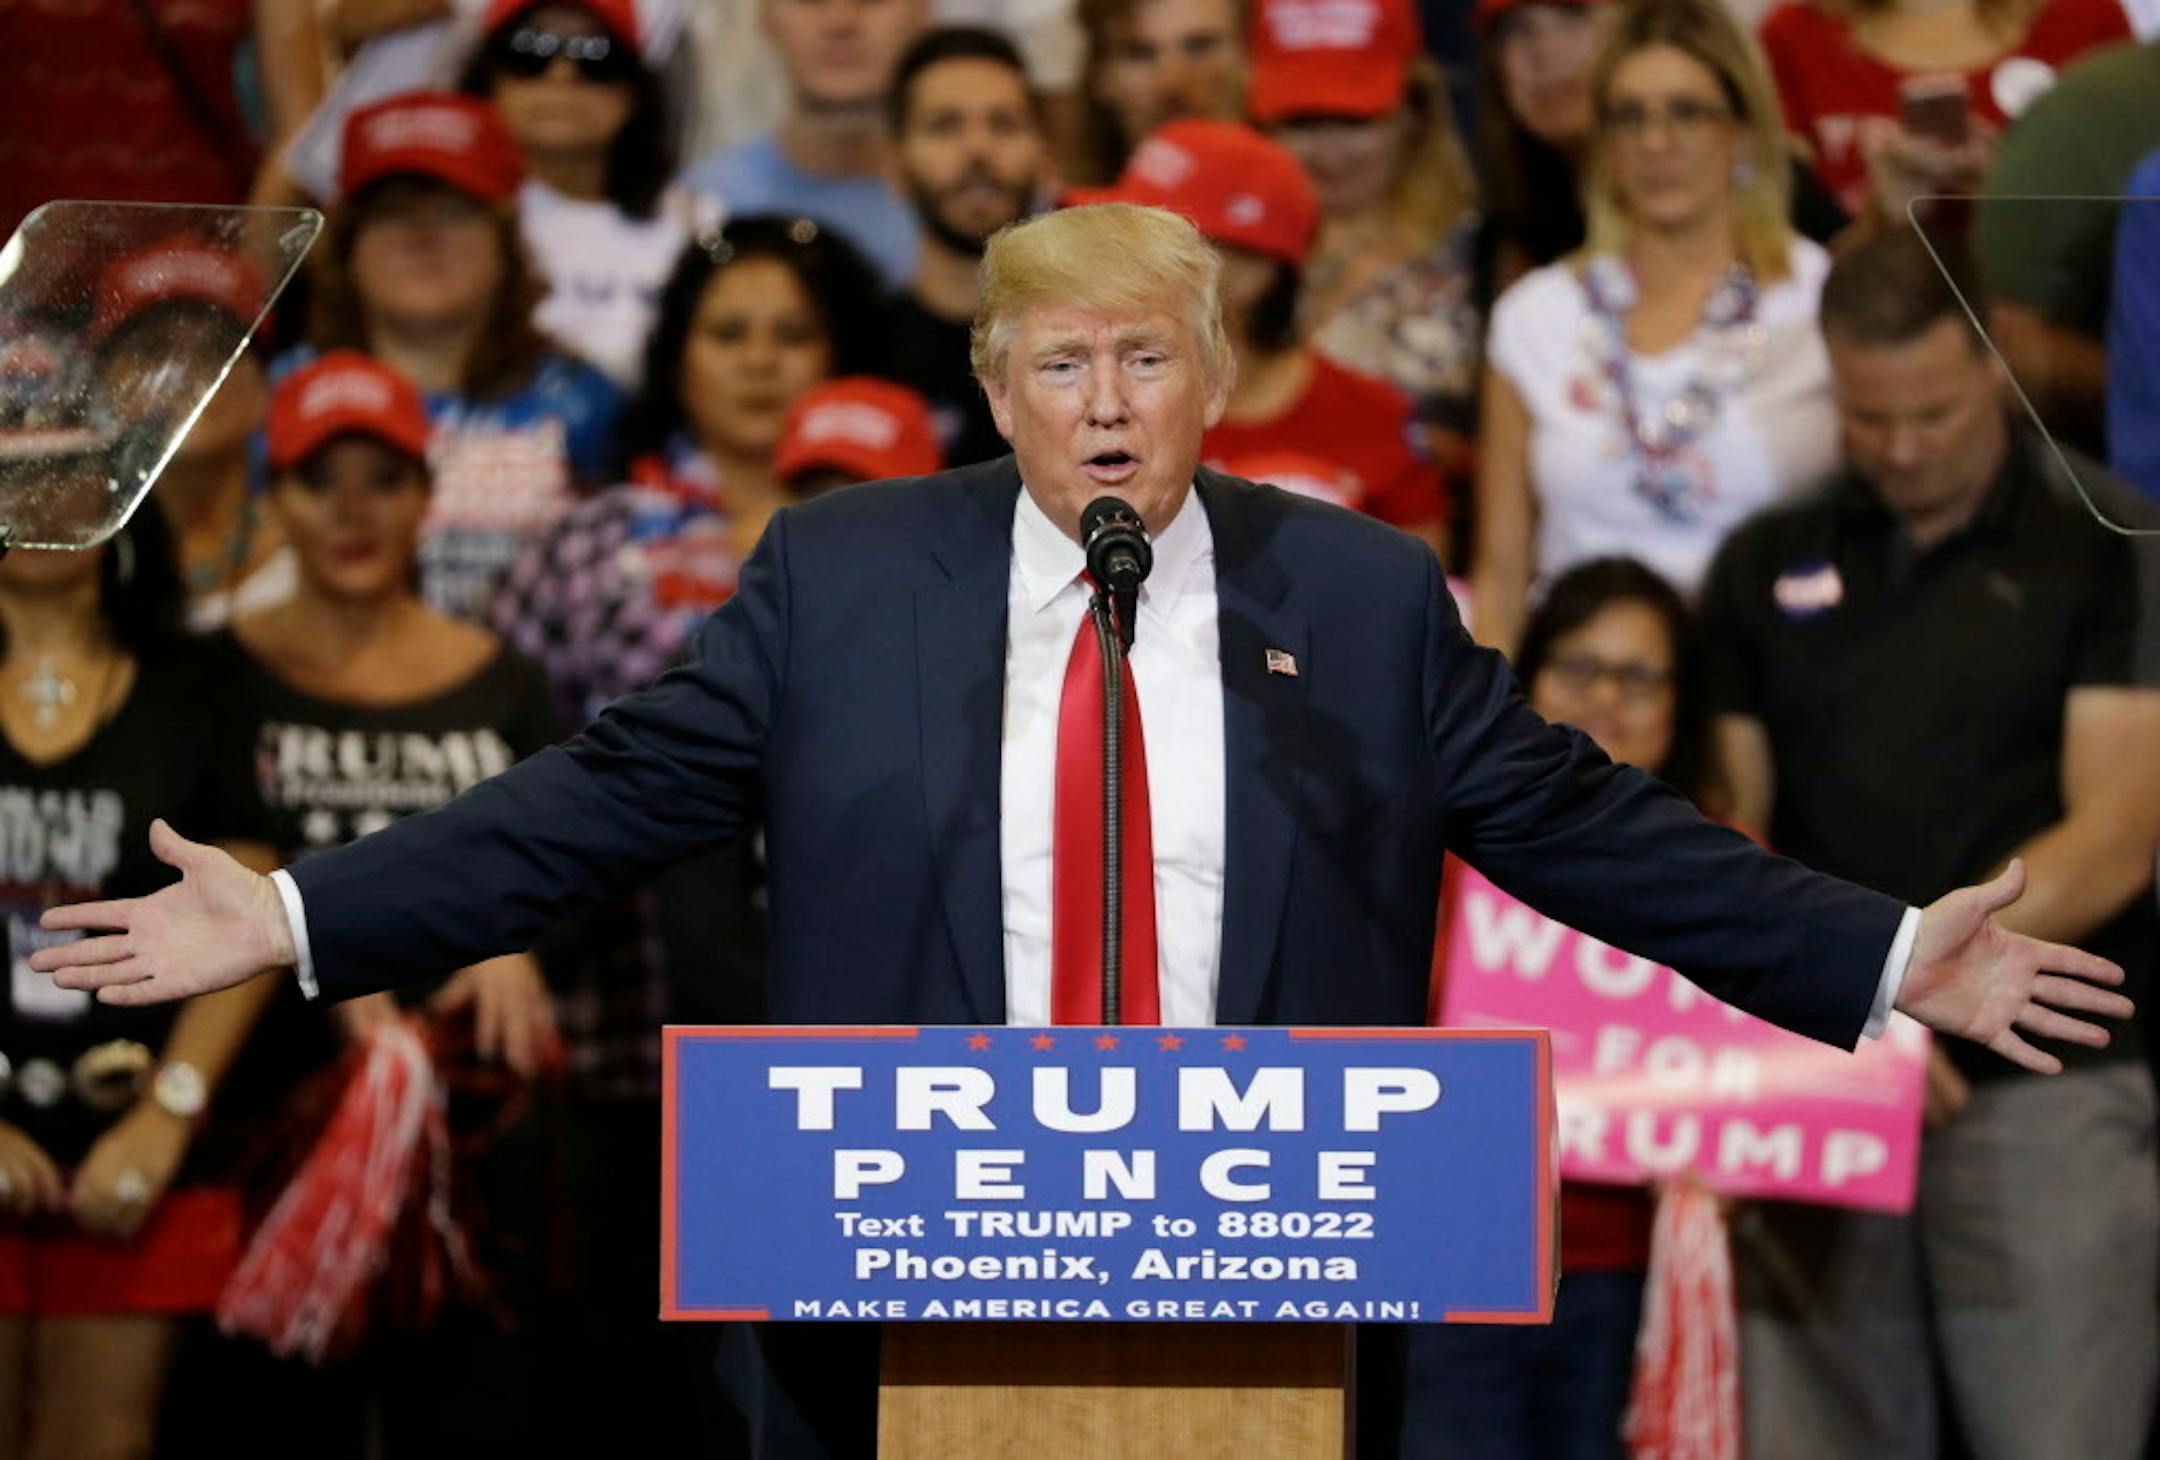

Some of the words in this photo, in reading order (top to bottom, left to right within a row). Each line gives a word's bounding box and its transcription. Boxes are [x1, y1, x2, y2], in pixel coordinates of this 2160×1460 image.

[768, 1066, 1442, 1133] TRUMP
[1557, 1098, 1890, 1188] RUMP
[834, 1148, 1377, 1202] PENCE
[834, 1211, 925, 1238] Text
[944, 1211, 1132, 1238] TRUMP
[1151, 1213, 1197, 1238] to
[1217, 1211, 1375, 1238] 88022
[855, 1248, 1109, 1285] Phoenix,
[1131, 1248, 1358, 1281] Arizona
[793, 1299, 907, 1319] MAKE
[922, 1298, 1112, 1319] AMERICA
[1125, 1299, 1260, 1319] GREAT
[1275, 1300, 1420, 1320] AGAIN!
